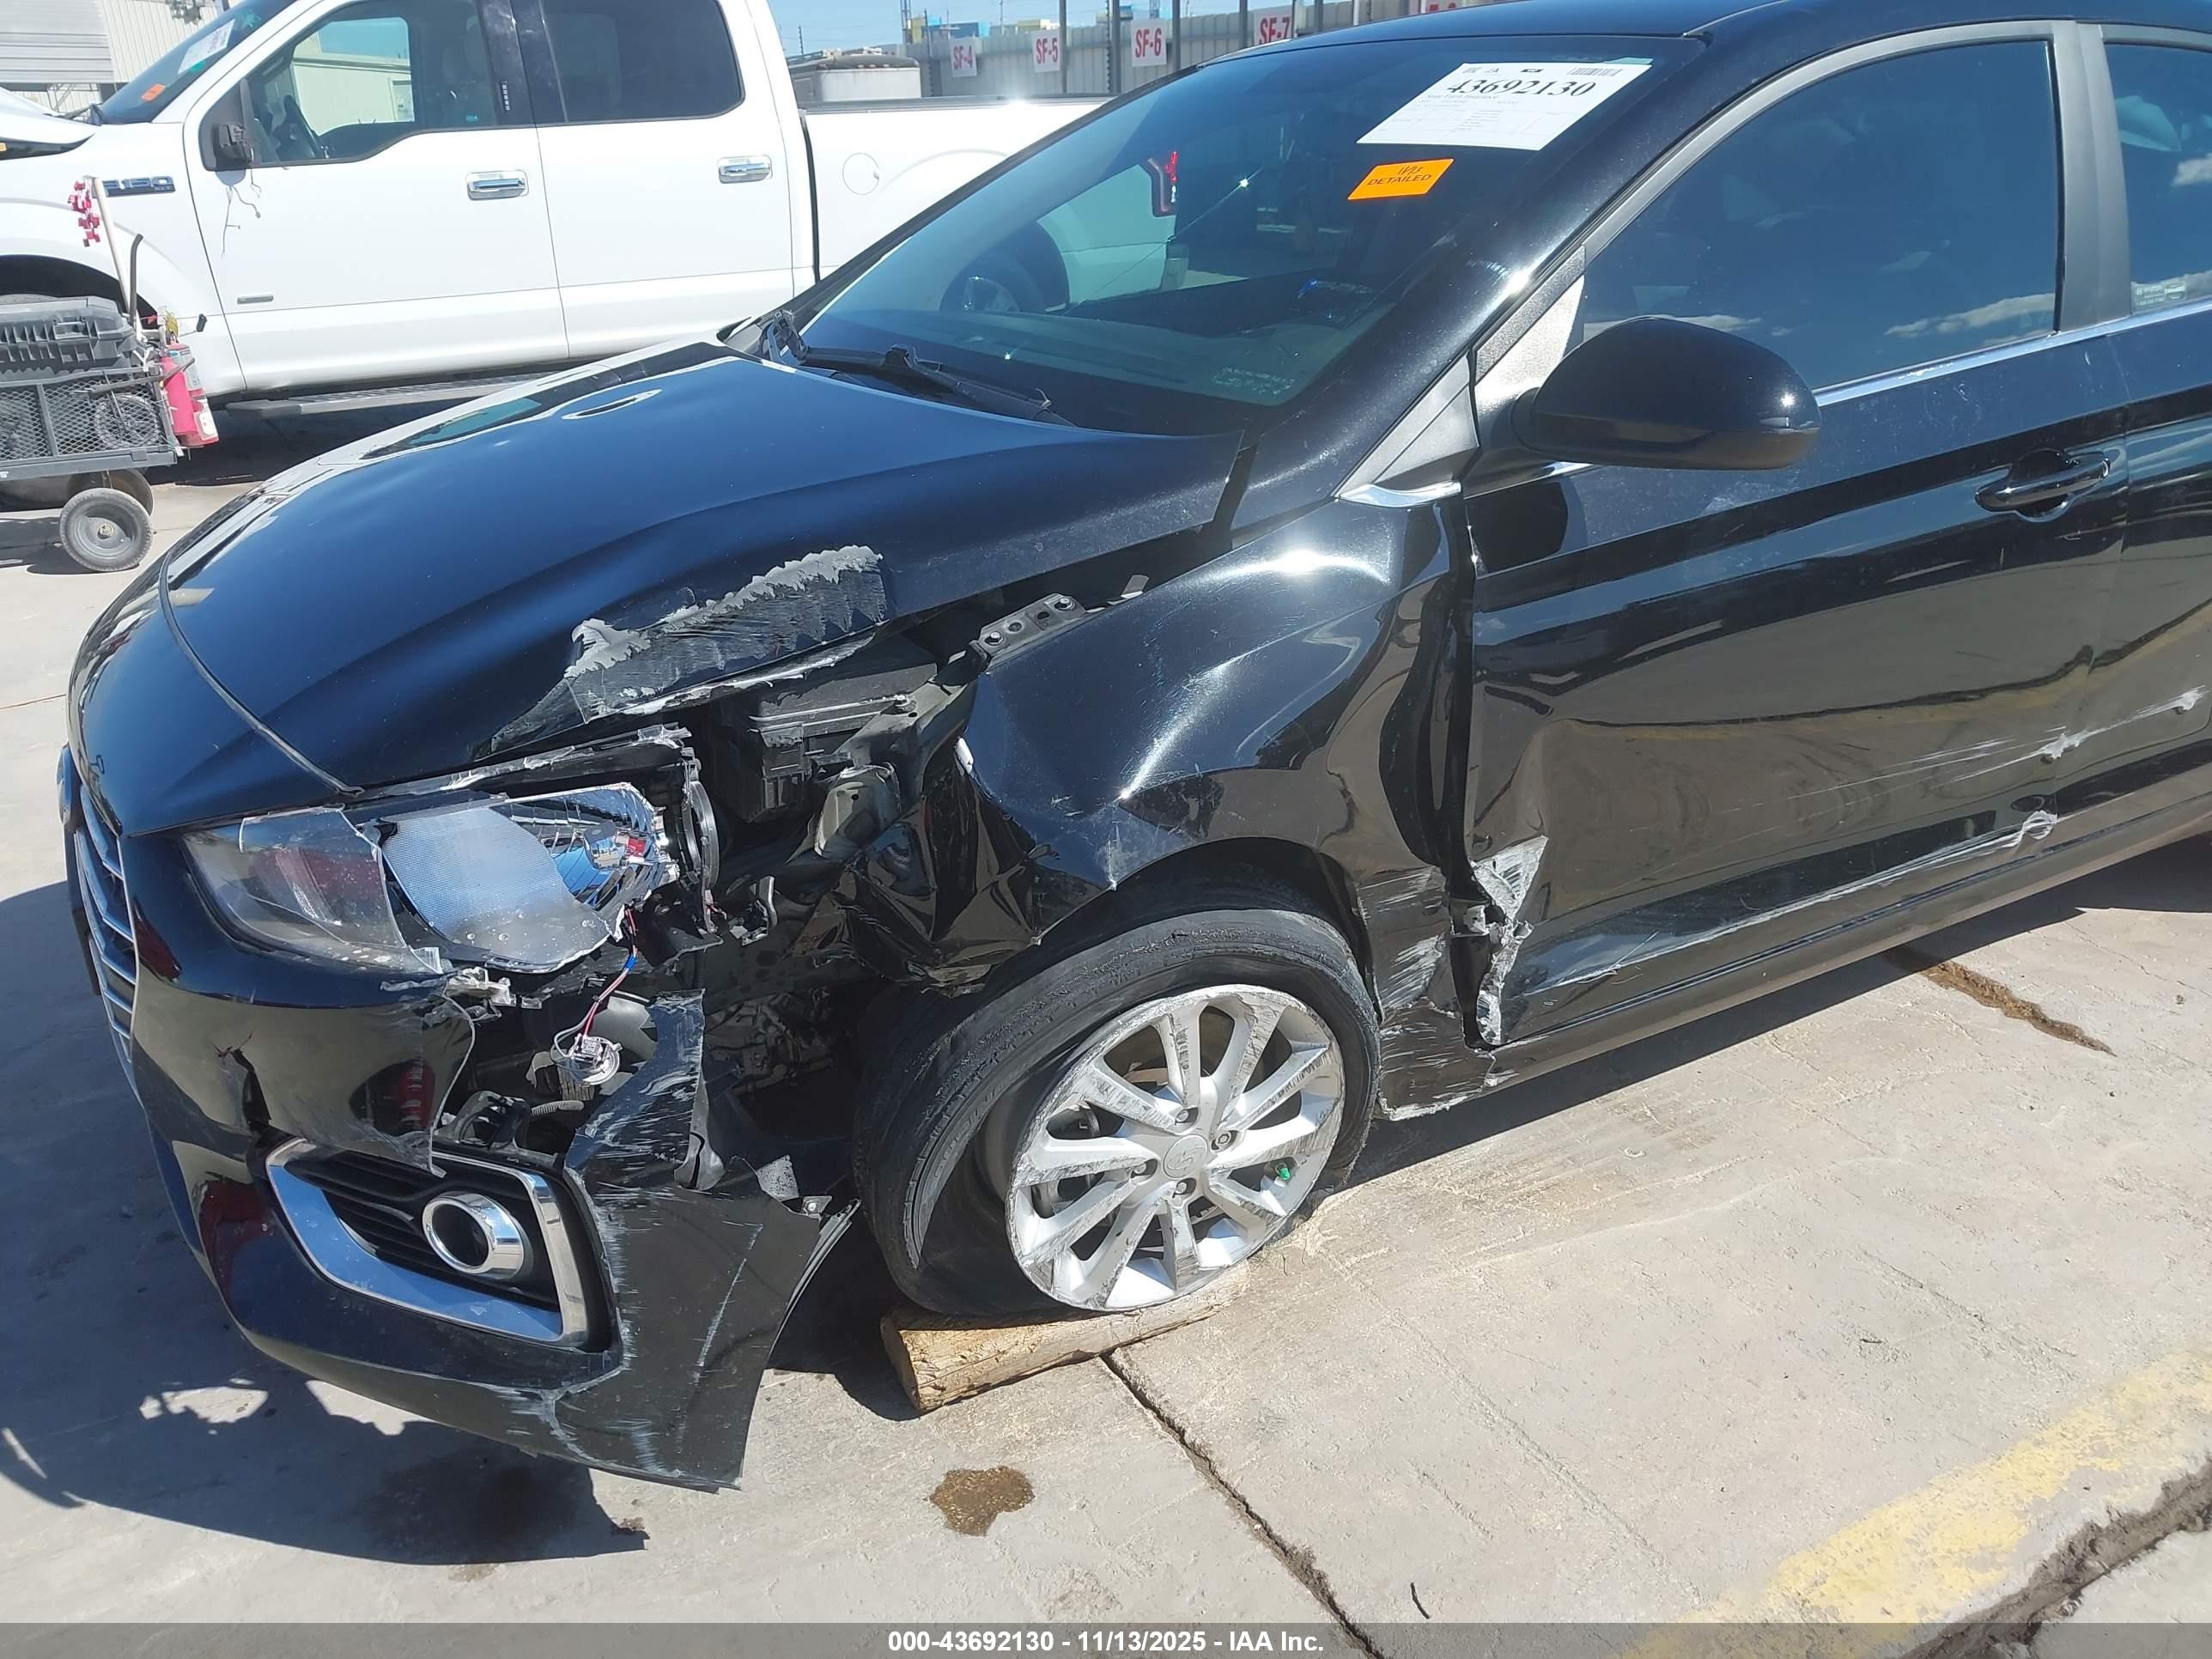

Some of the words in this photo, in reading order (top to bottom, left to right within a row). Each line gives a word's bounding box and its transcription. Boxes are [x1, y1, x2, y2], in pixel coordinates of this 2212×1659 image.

[1134, 27, 1163, 58] SF-6
[1260, 16, 1291, 45] SF-7
[952, 46, 974, 70] SF-4
[1036, 37, 1059, 64] SF-5
[1446, 78, 1597, 97] 43692130
[1367, 174, 1432, 185] DETAILED
